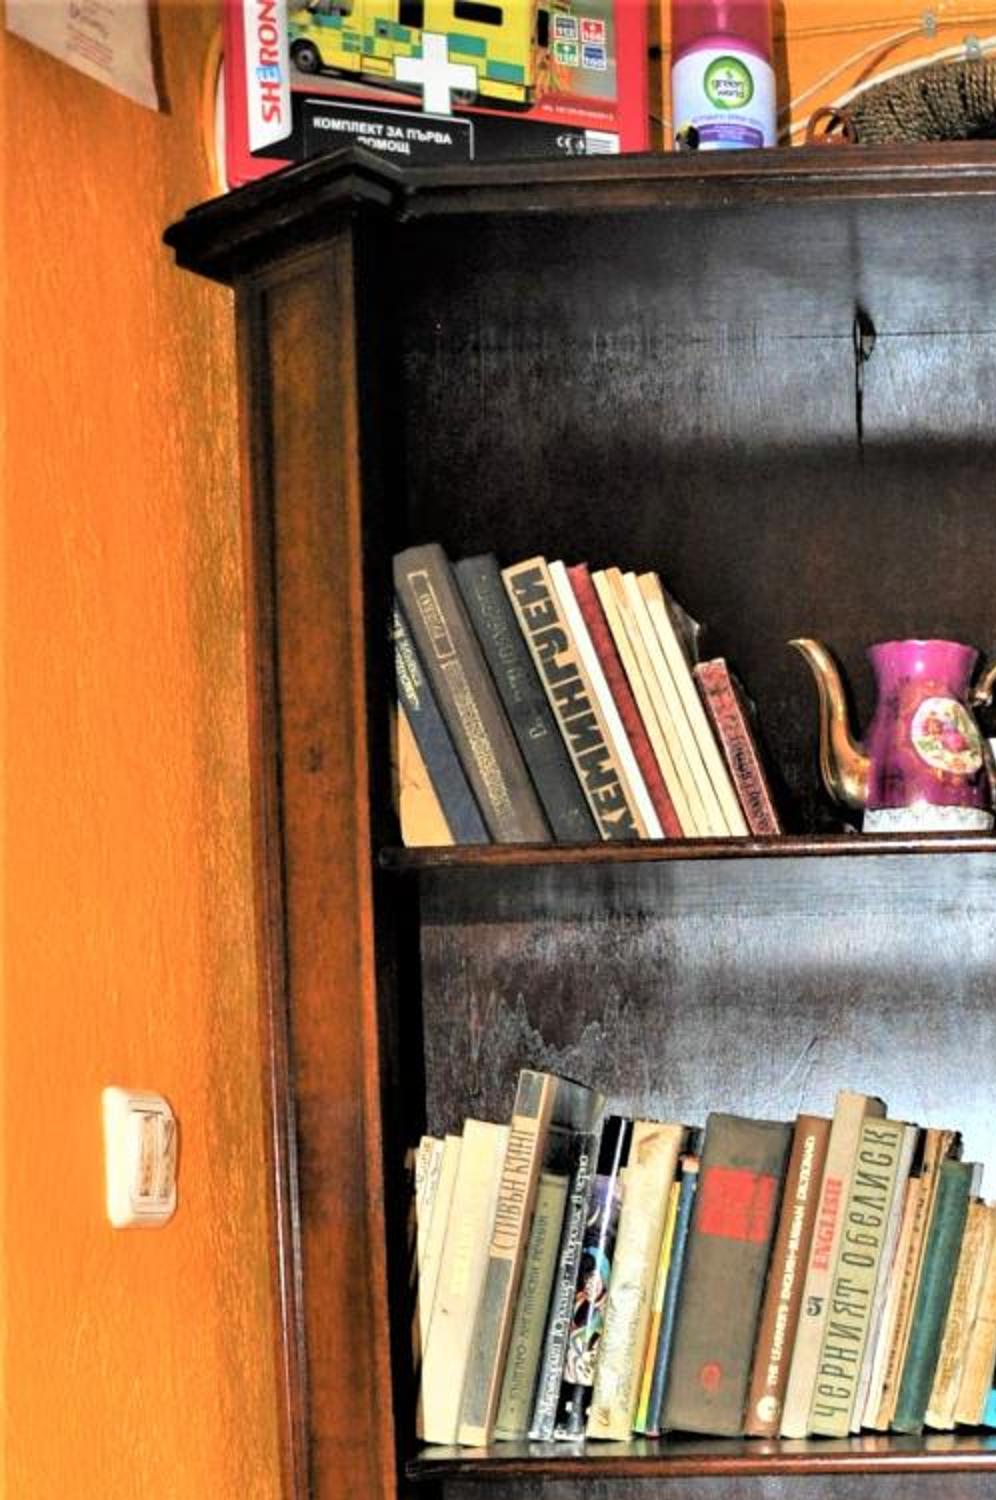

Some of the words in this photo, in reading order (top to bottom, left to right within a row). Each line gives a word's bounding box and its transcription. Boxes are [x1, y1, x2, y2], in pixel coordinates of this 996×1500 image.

[257, 0, 282, 124] SHERON
[313, 116, 384, 136] КОМПЛЕКТ
[386, 127, 404, 139] ЗА
[406, 128, 453, 145] ПЪРВА
[503, 1129, 534, 1175] КИНГ
[492, 1179, 527, 1249] СТИВЪН
[812, 1177, 842, 1270] ENGLISH
[767, 1363, 779, 1386] THE
